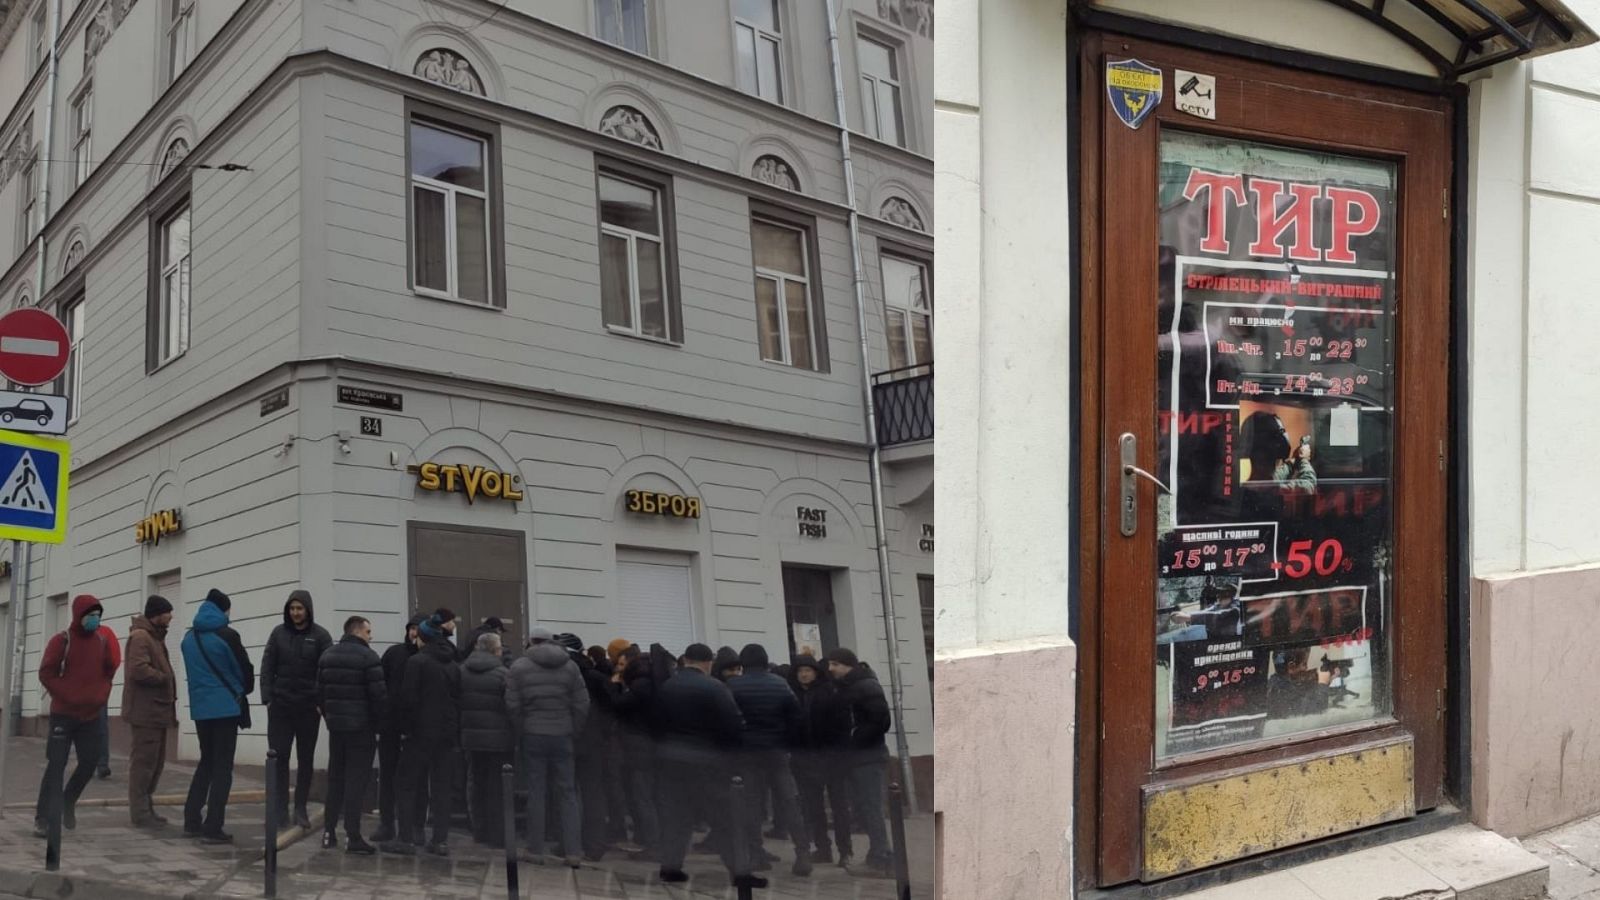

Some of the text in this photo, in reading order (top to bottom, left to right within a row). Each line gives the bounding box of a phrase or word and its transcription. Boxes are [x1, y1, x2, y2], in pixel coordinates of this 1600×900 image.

[1181, 102, 1210, 116] CCTV
[1183, 168, 1381, 264] ТИР
[1229, 316, 1244, 326] ми
[1310, 352, 1322, 362] до
[1313, 387, 1324, 397] до
[364, 418, 380, 434] 34
[1157, 410, 1223, 435] ТИР
[420, 462, 523, 505] STVOL
[627, 490, 701, 518] ЗБРОЯ
[1280, 487, 1383, 517] ТИР
[797, 506, 827, 522] FAST
[135, 509, 178, 546] STVOL
[799, 522, 827, 538] FISH
[1182, 530, 1222, 542] щасливі
[1162, 566, 1170, 574] з
[1204, 562, 1217, 572] до
[1207, 641, 1242, 653] оренда
